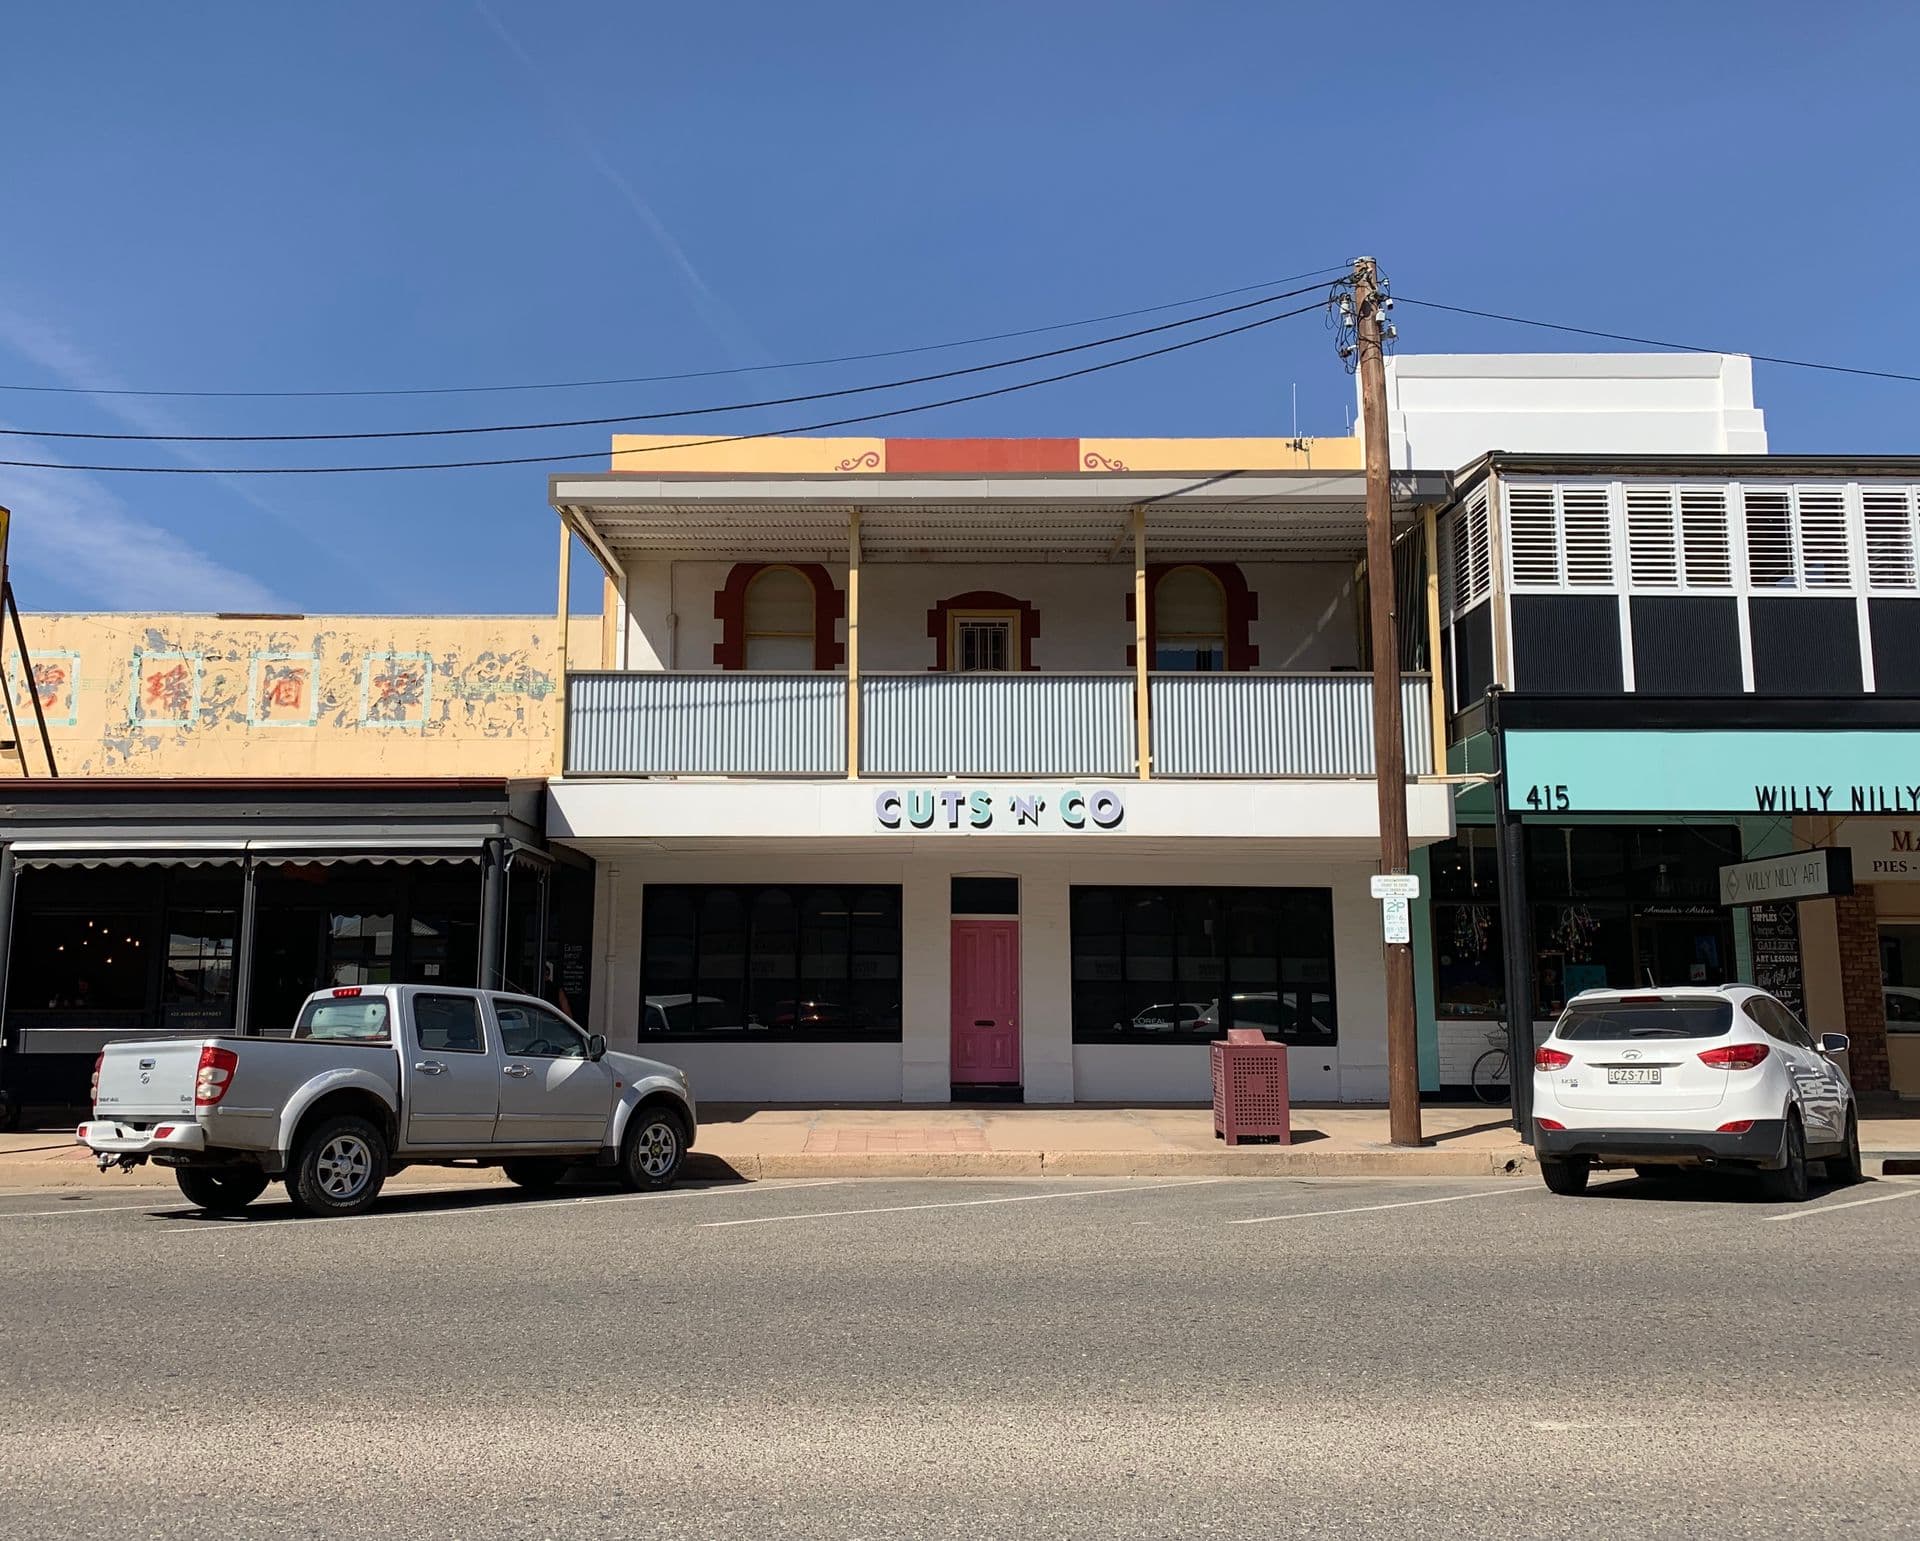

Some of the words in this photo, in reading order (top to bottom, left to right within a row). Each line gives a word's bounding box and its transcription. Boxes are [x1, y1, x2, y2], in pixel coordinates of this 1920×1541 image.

[875, 790, 993, 829] CUTS
[1059, 790, 1125, 829] CO
[1526, 785, 1570, 810] 415
[1755, 785, 1832, 812] WILLY
[1851, 785, 1920, 812] NILLY
[1745, 871, 1772, 892] WILLY
[1775, 866, 1798, 888] NILLY
[1803, 862, 1821, 884] ART
[1872, 860, 1908, 873] PIES
[1757, 941, 1796, 950] GALLERY
[1756, 955, 1768, 963] ART
[1770, 955, 1798, 963] LESSONS
